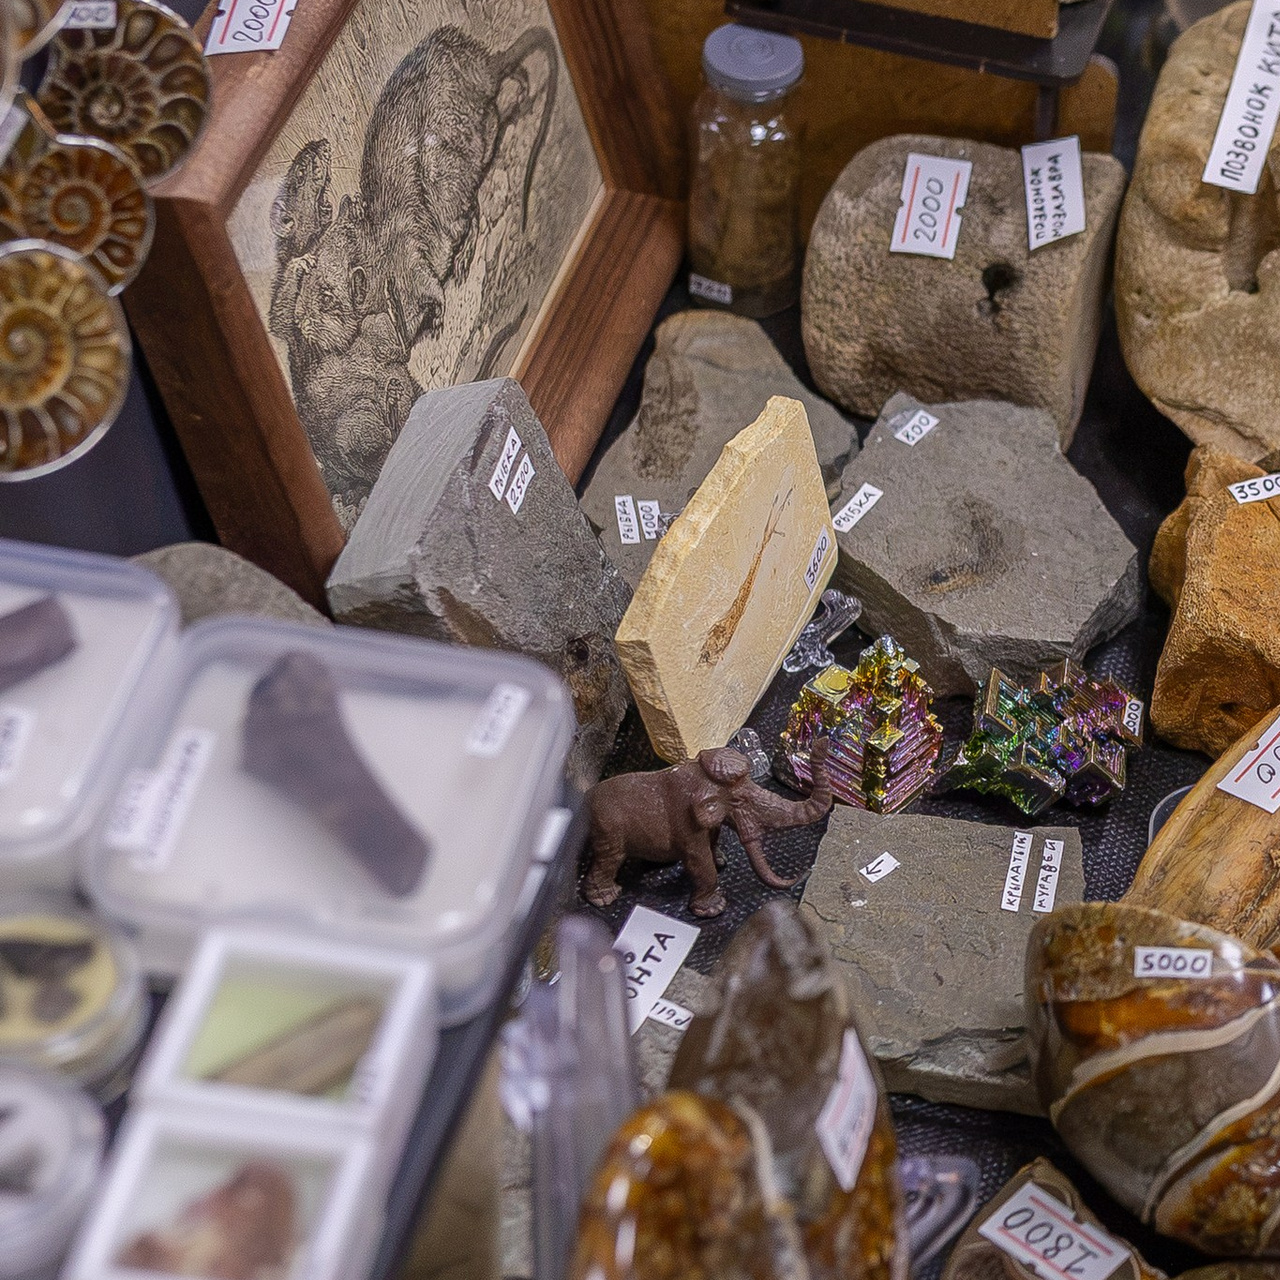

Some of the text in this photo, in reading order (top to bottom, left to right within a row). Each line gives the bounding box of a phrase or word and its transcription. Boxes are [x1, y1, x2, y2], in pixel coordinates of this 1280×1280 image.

[1220, 82, 1274, 181] ПОЗВОНОК
[913, 177, 943, 243] 2000
[901, 415, 930, 442] 800
[494, 438, 518, 494] РЫБКА
[509, 463, 530, 506] 2500
[617, 500, 634, 541] РЫБКА
[640, 504, 656, 540] 1000
[834, 489, 877, 527] РЫБКА
[1006, 833, 1028, 906] КРЫЛАТЫЙ
[1037, 840, 1058, 909] МУРАВЕЙ
[1142, 953, 1208, 971] 5000
[1002, 1205, 1099, 1277] 1800
